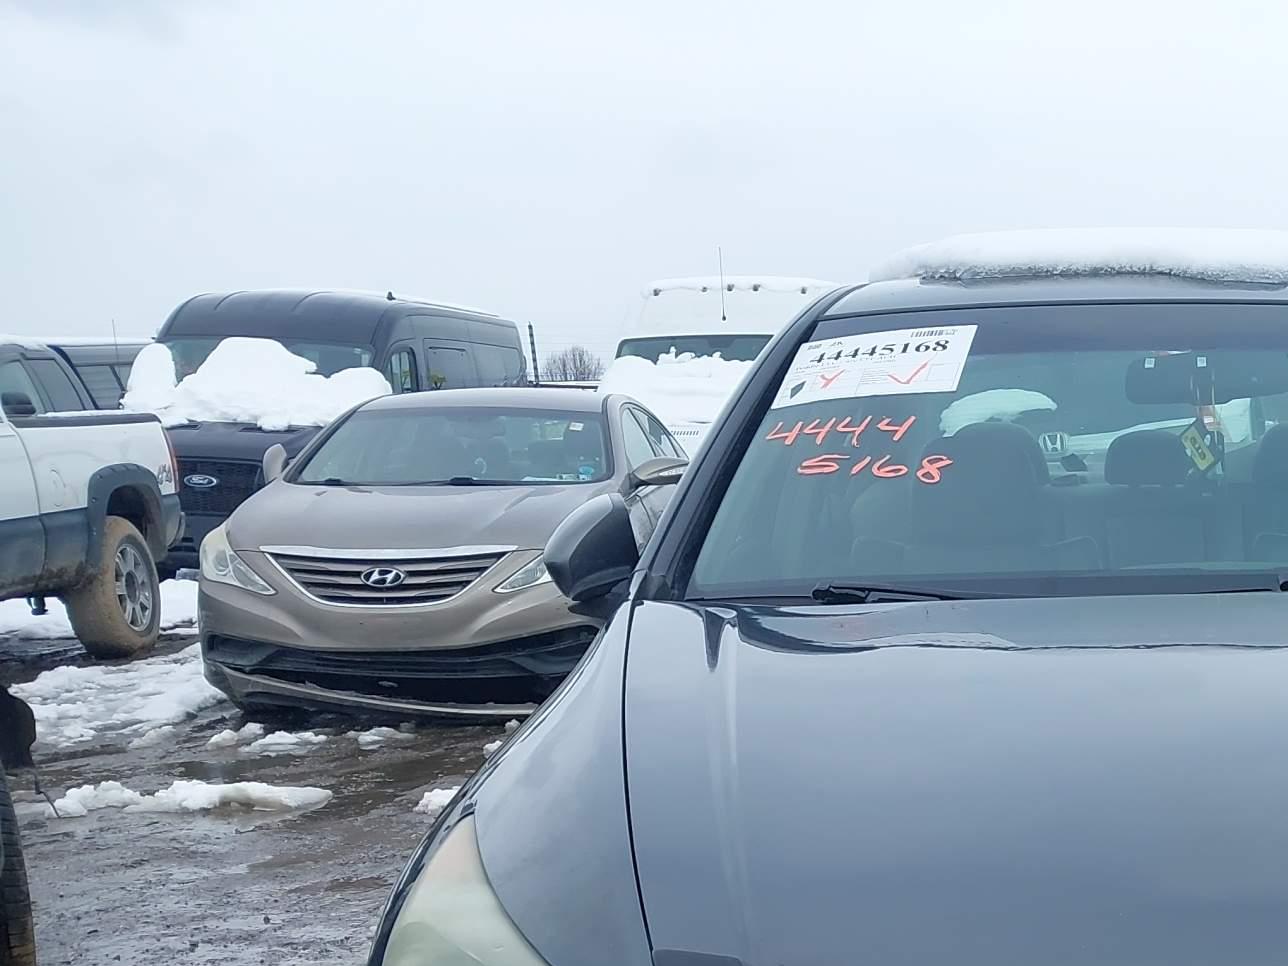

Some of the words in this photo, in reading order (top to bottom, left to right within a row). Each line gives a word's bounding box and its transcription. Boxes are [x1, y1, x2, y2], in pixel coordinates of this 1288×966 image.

[810, 339, 950, 363] 44445168
[765, 415, 916, 448] 4444
[797, 454, 954, 484] 5168
